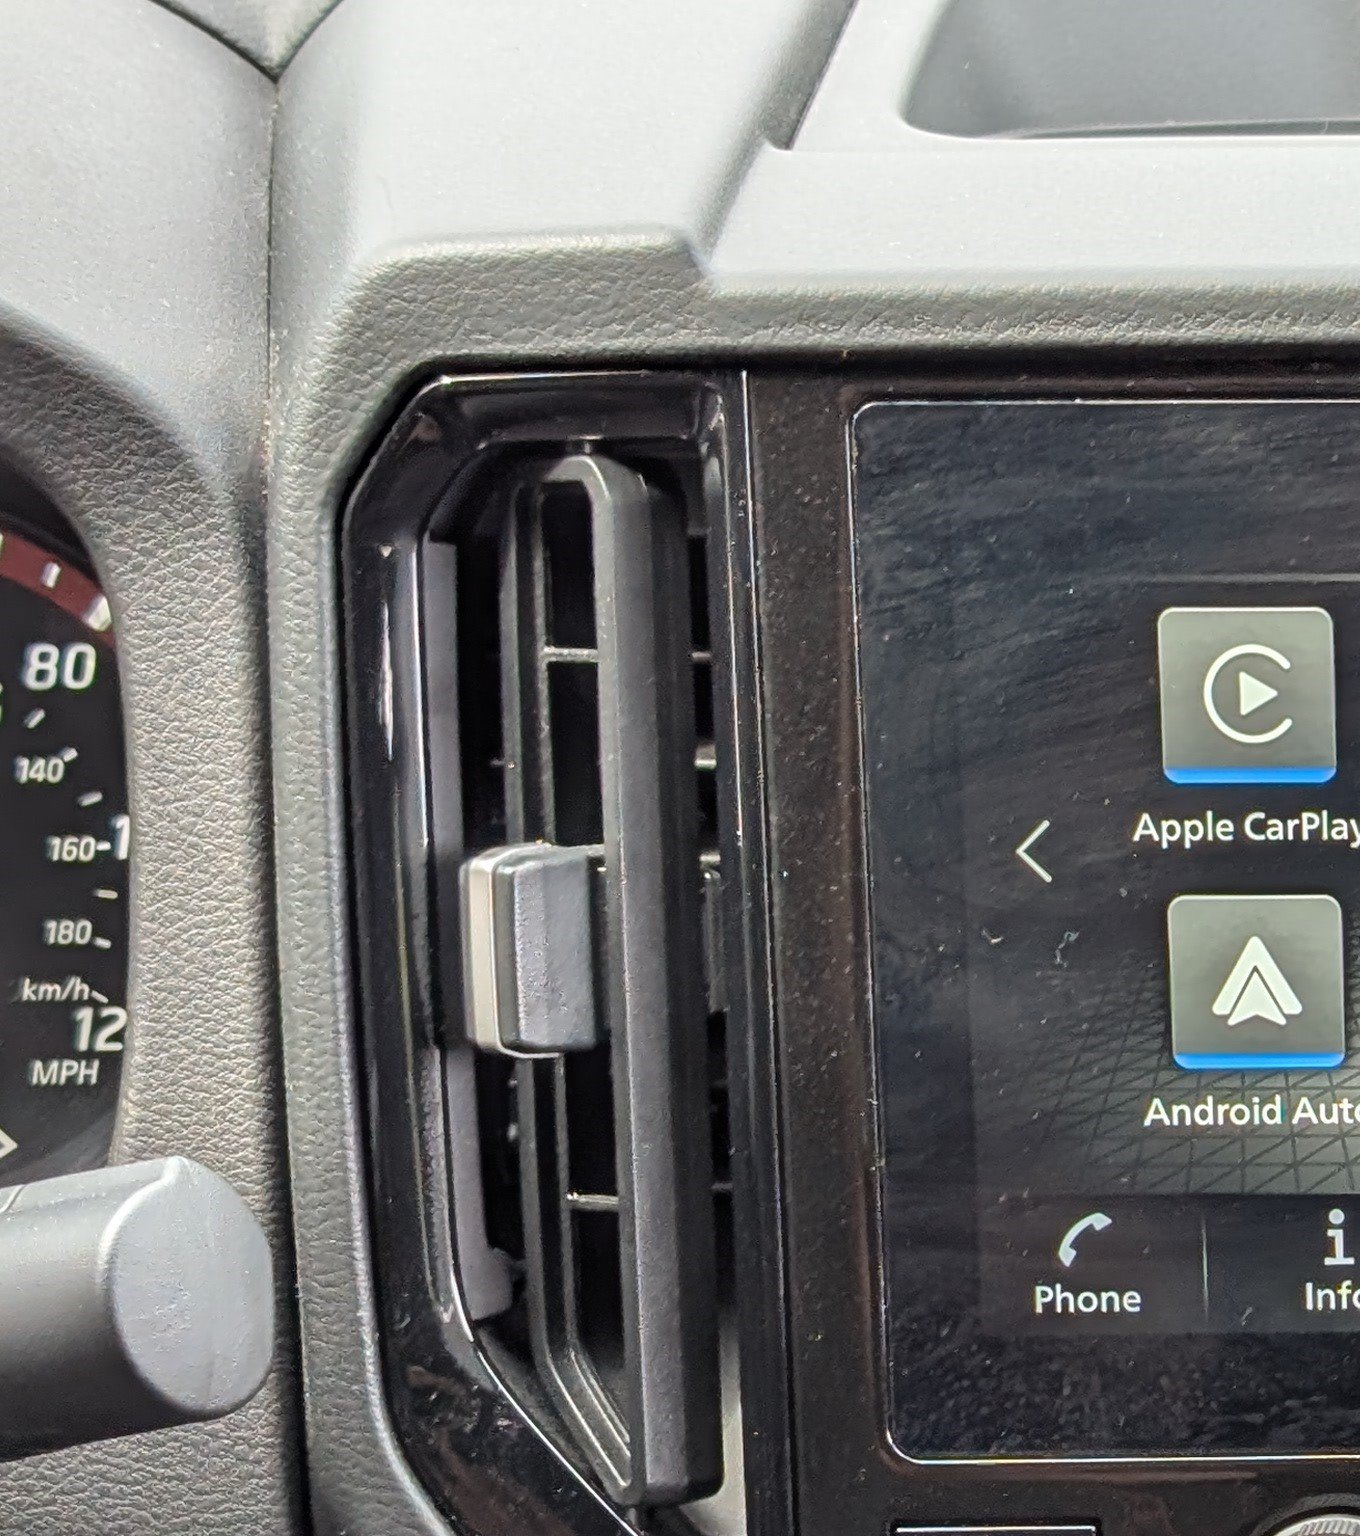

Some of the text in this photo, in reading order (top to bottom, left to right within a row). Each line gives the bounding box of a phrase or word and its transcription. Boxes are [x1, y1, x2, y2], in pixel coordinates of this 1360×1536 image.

[24, 642, 97, 690] 80
[15, 755, 66, 784] 140
[1132, 811, 1235, 849] Apple
[47, 834, 96, 862] 160
[45, 918, 93, 945] 180
[21, 975, 91, 1001] km/h
[31, 1058, 100, 1086] MPH
[1142, 1095, 1283, 1128] Android
[1033, 1285, 1143, 1314] Phone
